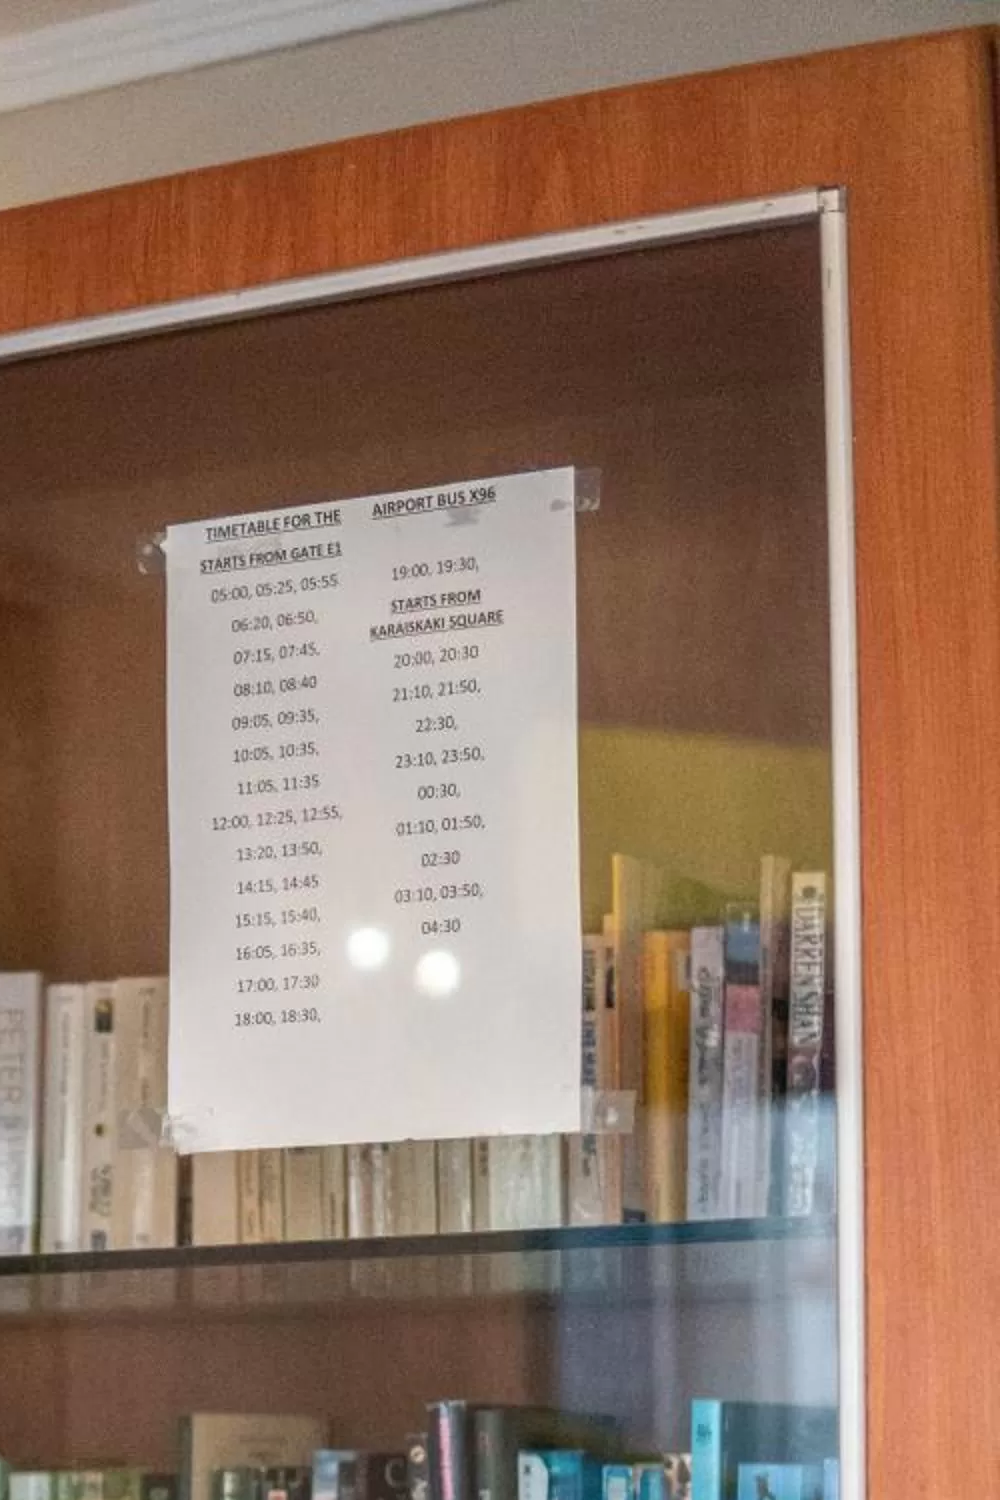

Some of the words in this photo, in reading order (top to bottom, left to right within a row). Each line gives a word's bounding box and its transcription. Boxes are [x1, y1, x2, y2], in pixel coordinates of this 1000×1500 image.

[205, 519, 280, 543] TIMETABLE
[283, 514, 312, 533] FOR
[315, 509, 342, 527] THE
[371, 498, 435, 520] AIRPORT
[438, 491, 466, 511] BUS
[469, 486, 496, 505] X96
[200, 555, 246, 573] STARTS
[249, 549, 288, 568] FROM
[290, 544, 324, 563] GATE
[327, 541, 342, 559] E1
[391, 595, 433, 613] STARTS
[440, 588, 481, 606] FROM
[370, 617, 446, 641] KARAISKAKI
[449, 609, 504, 628] SQUARE
[421, 850, 460, 868] 02:30
[421, 918, 461, 935] 04:30
